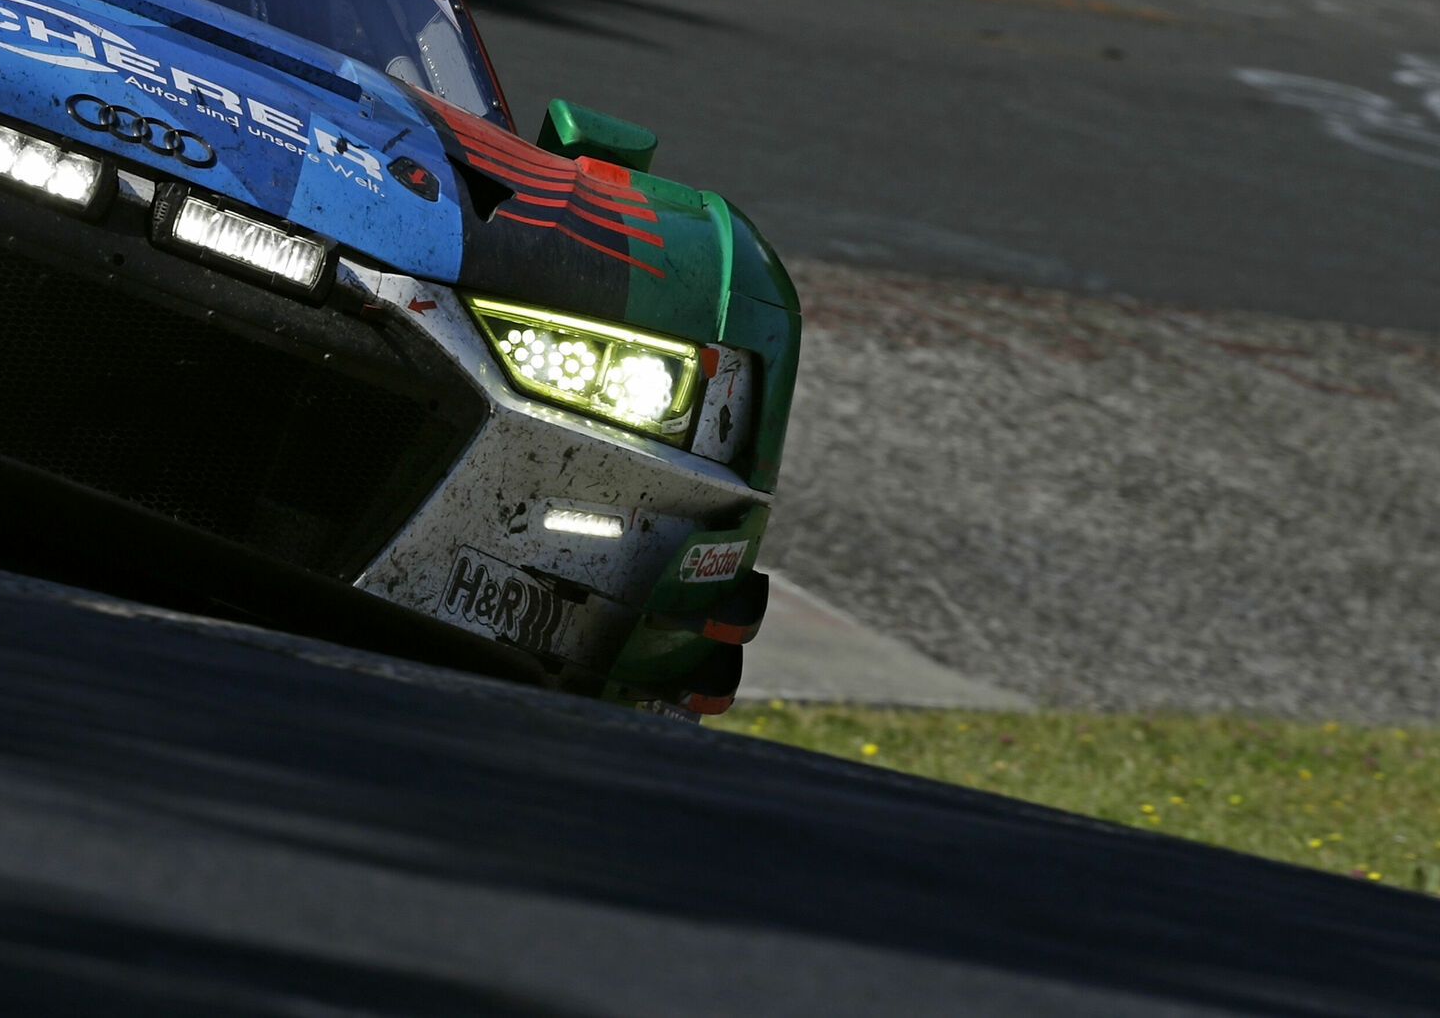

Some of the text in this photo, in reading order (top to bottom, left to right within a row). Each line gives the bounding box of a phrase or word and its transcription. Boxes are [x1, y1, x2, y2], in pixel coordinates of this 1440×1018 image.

[124, 75, 189, 107] Autos
[196, 102, 240, 128] sind
[248, 123, 320, 164] unsere
[447, 557, 524, 633] H&R
[696, 548, 744, 578] Castrol
